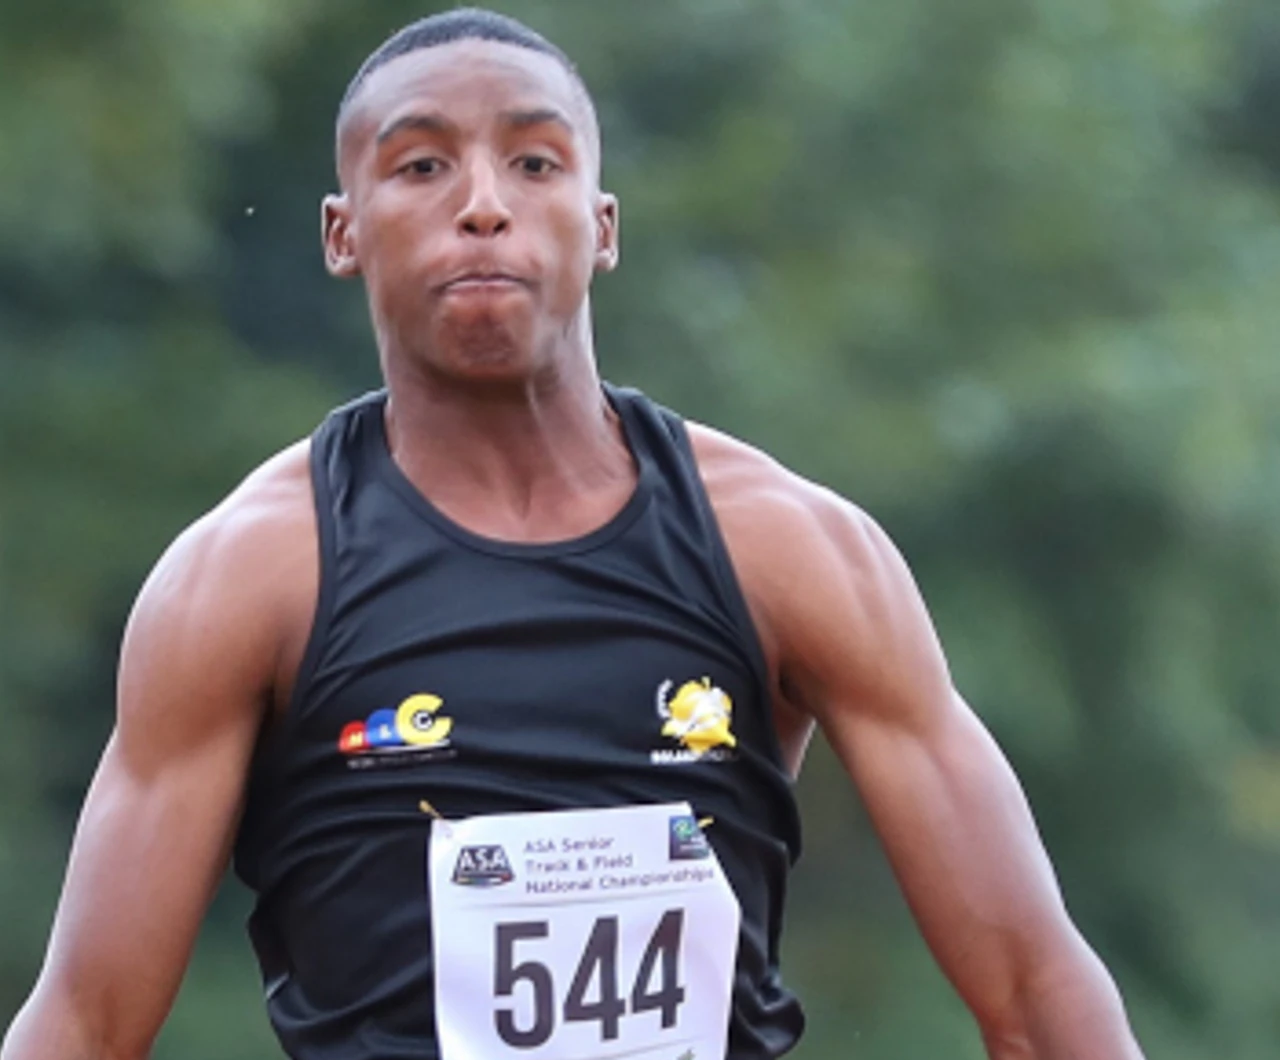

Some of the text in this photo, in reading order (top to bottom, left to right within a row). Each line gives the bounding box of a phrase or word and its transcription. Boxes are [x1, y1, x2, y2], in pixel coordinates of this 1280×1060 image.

[524, 836, 615, 853] ASA Senior
[460, 847, 507, 870] ASA
[525, 854, 633, 873] Track & Field
[526, 866, 714, 894] National Championships
[494, 907, 685, 1049] 544
